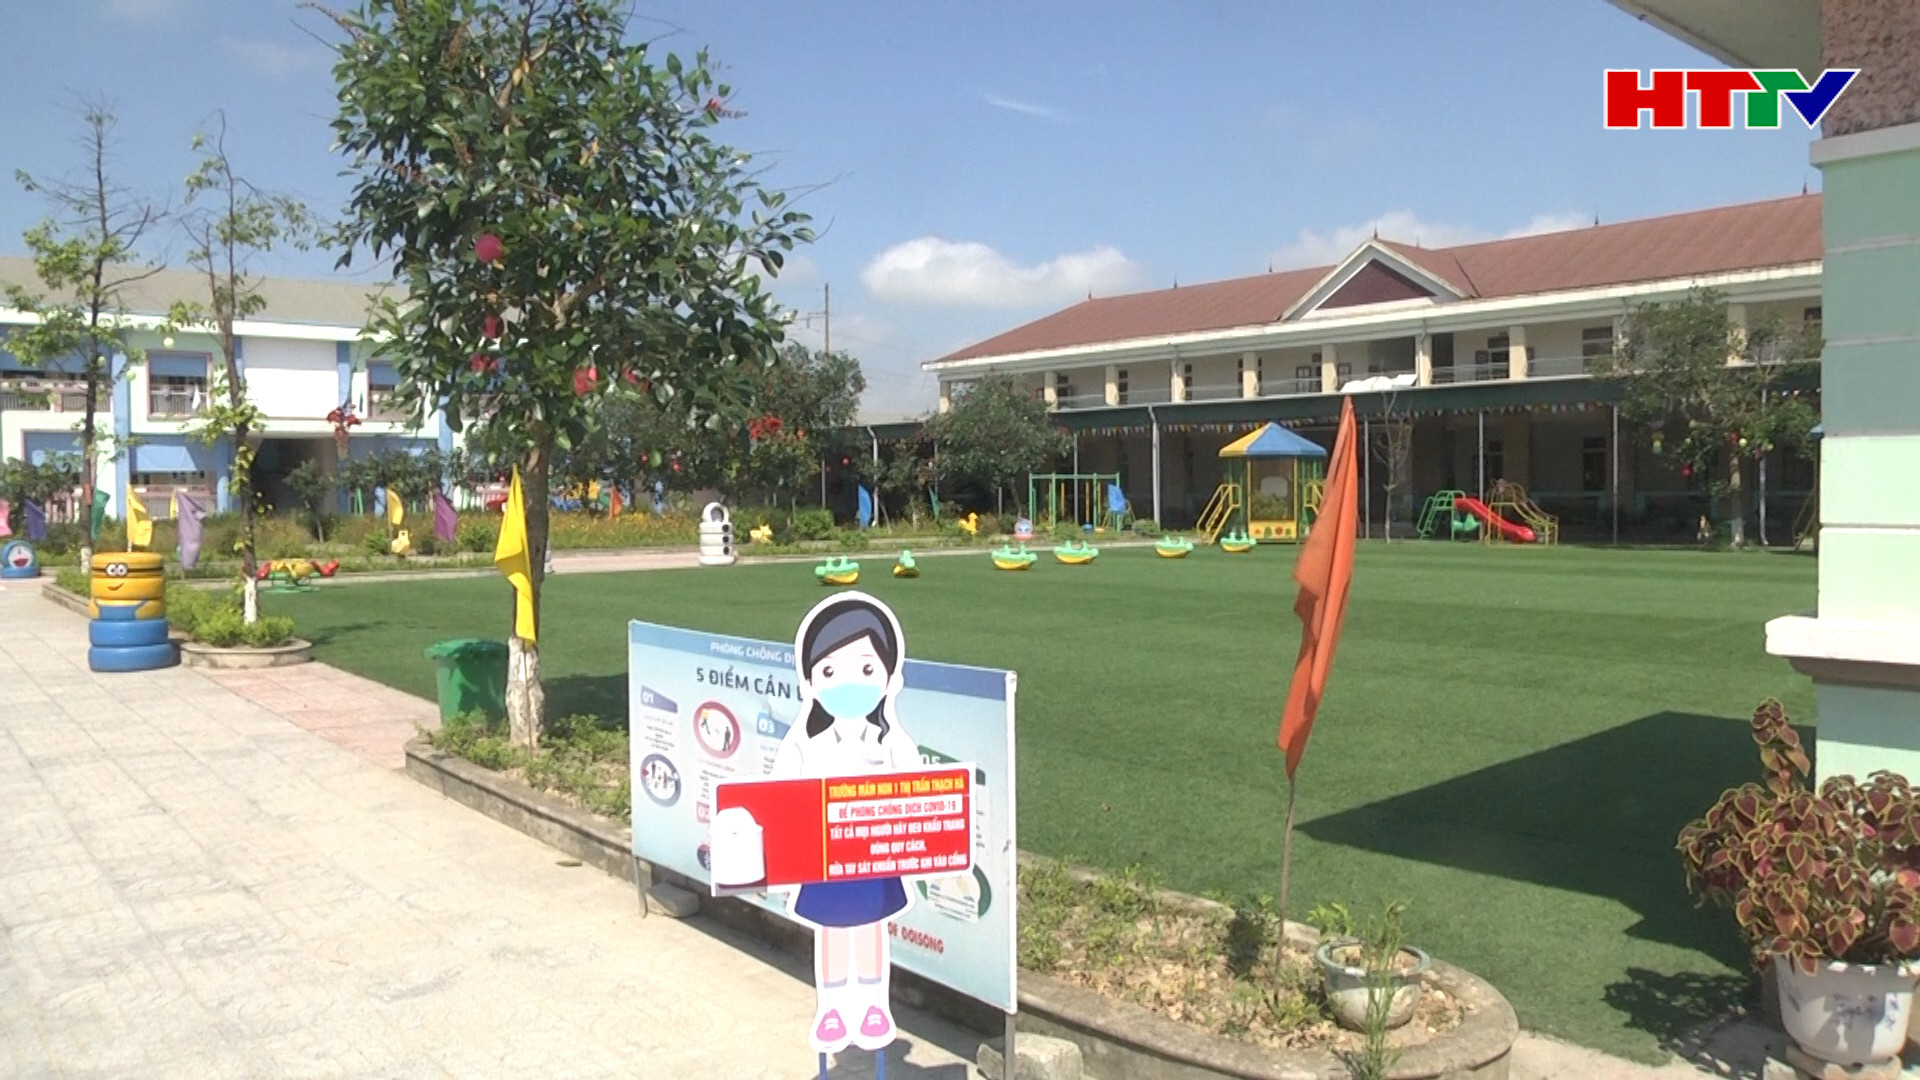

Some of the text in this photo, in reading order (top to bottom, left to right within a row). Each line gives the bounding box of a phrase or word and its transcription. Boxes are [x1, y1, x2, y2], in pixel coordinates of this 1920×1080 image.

[697, 667, 705, 683] 5
[759, 720, 775, 734] 03
[943, 818, 965, 831] TRANG
[890, 841, 905, 855] QUY
